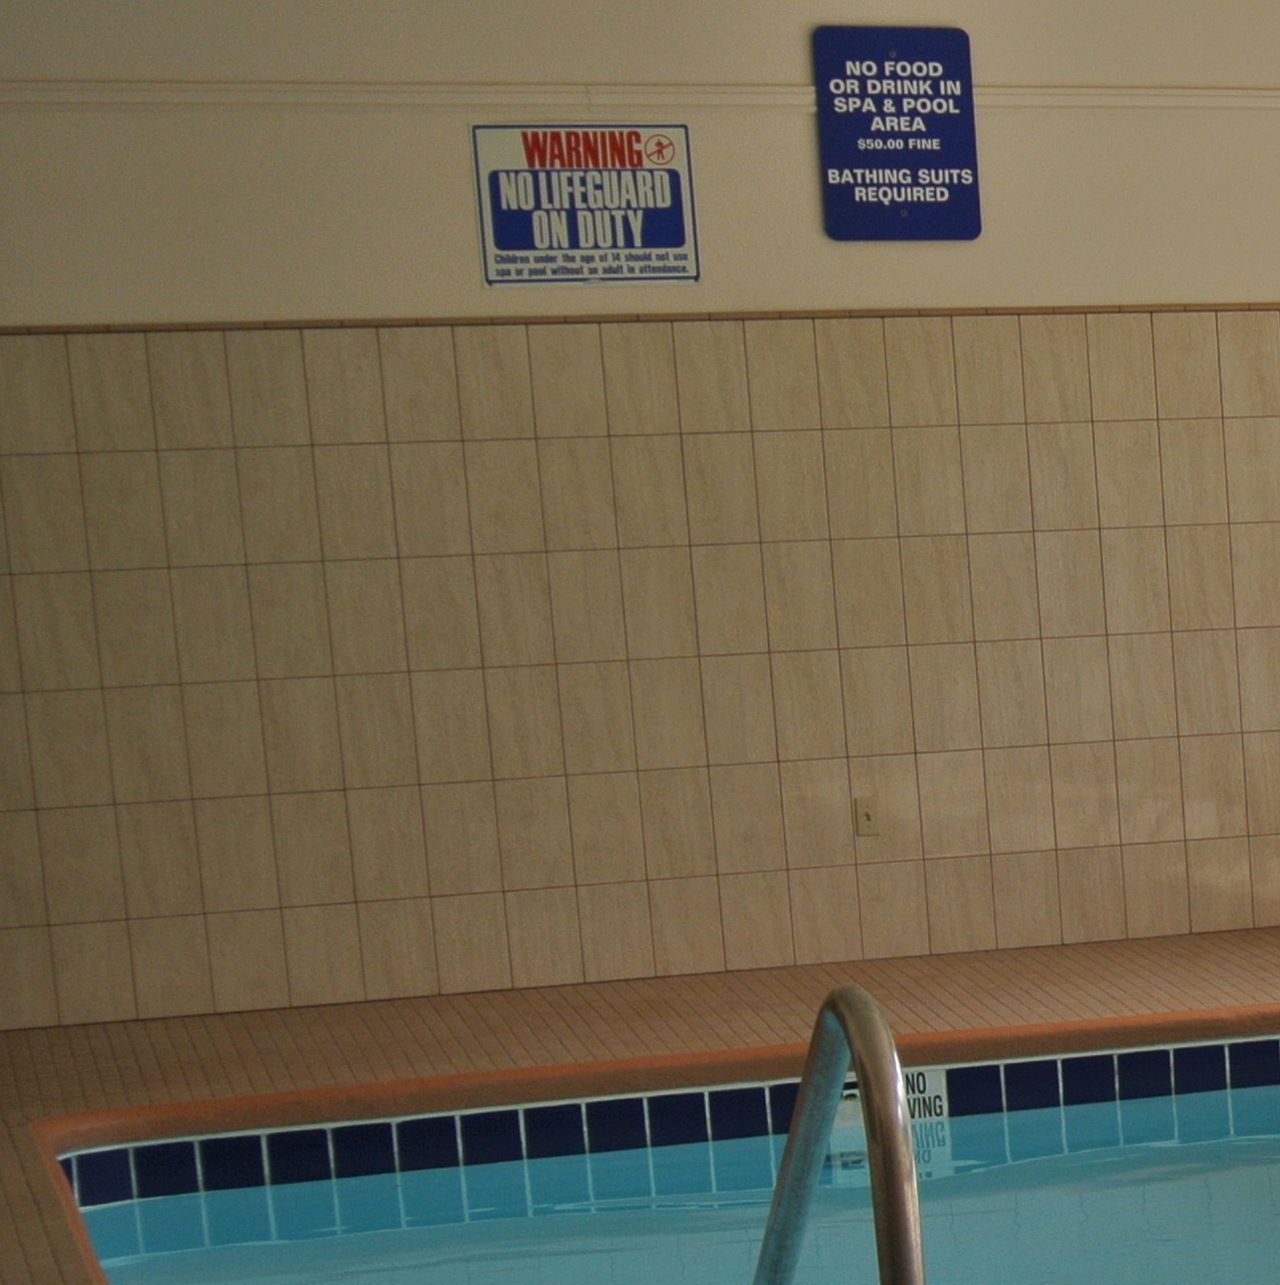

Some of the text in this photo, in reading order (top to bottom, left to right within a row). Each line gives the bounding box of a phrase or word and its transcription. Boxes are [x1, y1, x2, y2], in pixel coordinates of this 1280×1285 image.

[845, 61, 943, 77] NO FOOD
[829, 79, 961, 96] OR DRINK IN
[833, 97, 960, 114] SPA & POOL
[870, 116, 927, 132] AREA
[521, 130, 643, 169] WARNING
[857, 138, 941, 150] $50.00 FINE
[828, 168, 973, 185] BATHING SUITS
[498, 170, 671, 210] NO LIFEGUARD
[854, 186, 949, 205] REQUIRED
[532, 209, 645, 250] ON DUTY
[494, 253, 530, 264] Children
[533, 254, 558, 264] under
[562, 252, 576, 263] the
[580, 254, 595, 265] age
[625, 251, 652, 262] should
[655, 251, 669, 261] not
[672, 253, 688, 261] use
[514, 268, 524, 276] or
[527, 266, 547, 277] pool
[551, 265, 584, 276] without
[602, 264, 623, 274] adult
[639, 264, 688, 275] attendance.
[905, 1072, 927, 1094] NO
[907, 1095, 943, 1119] VING
